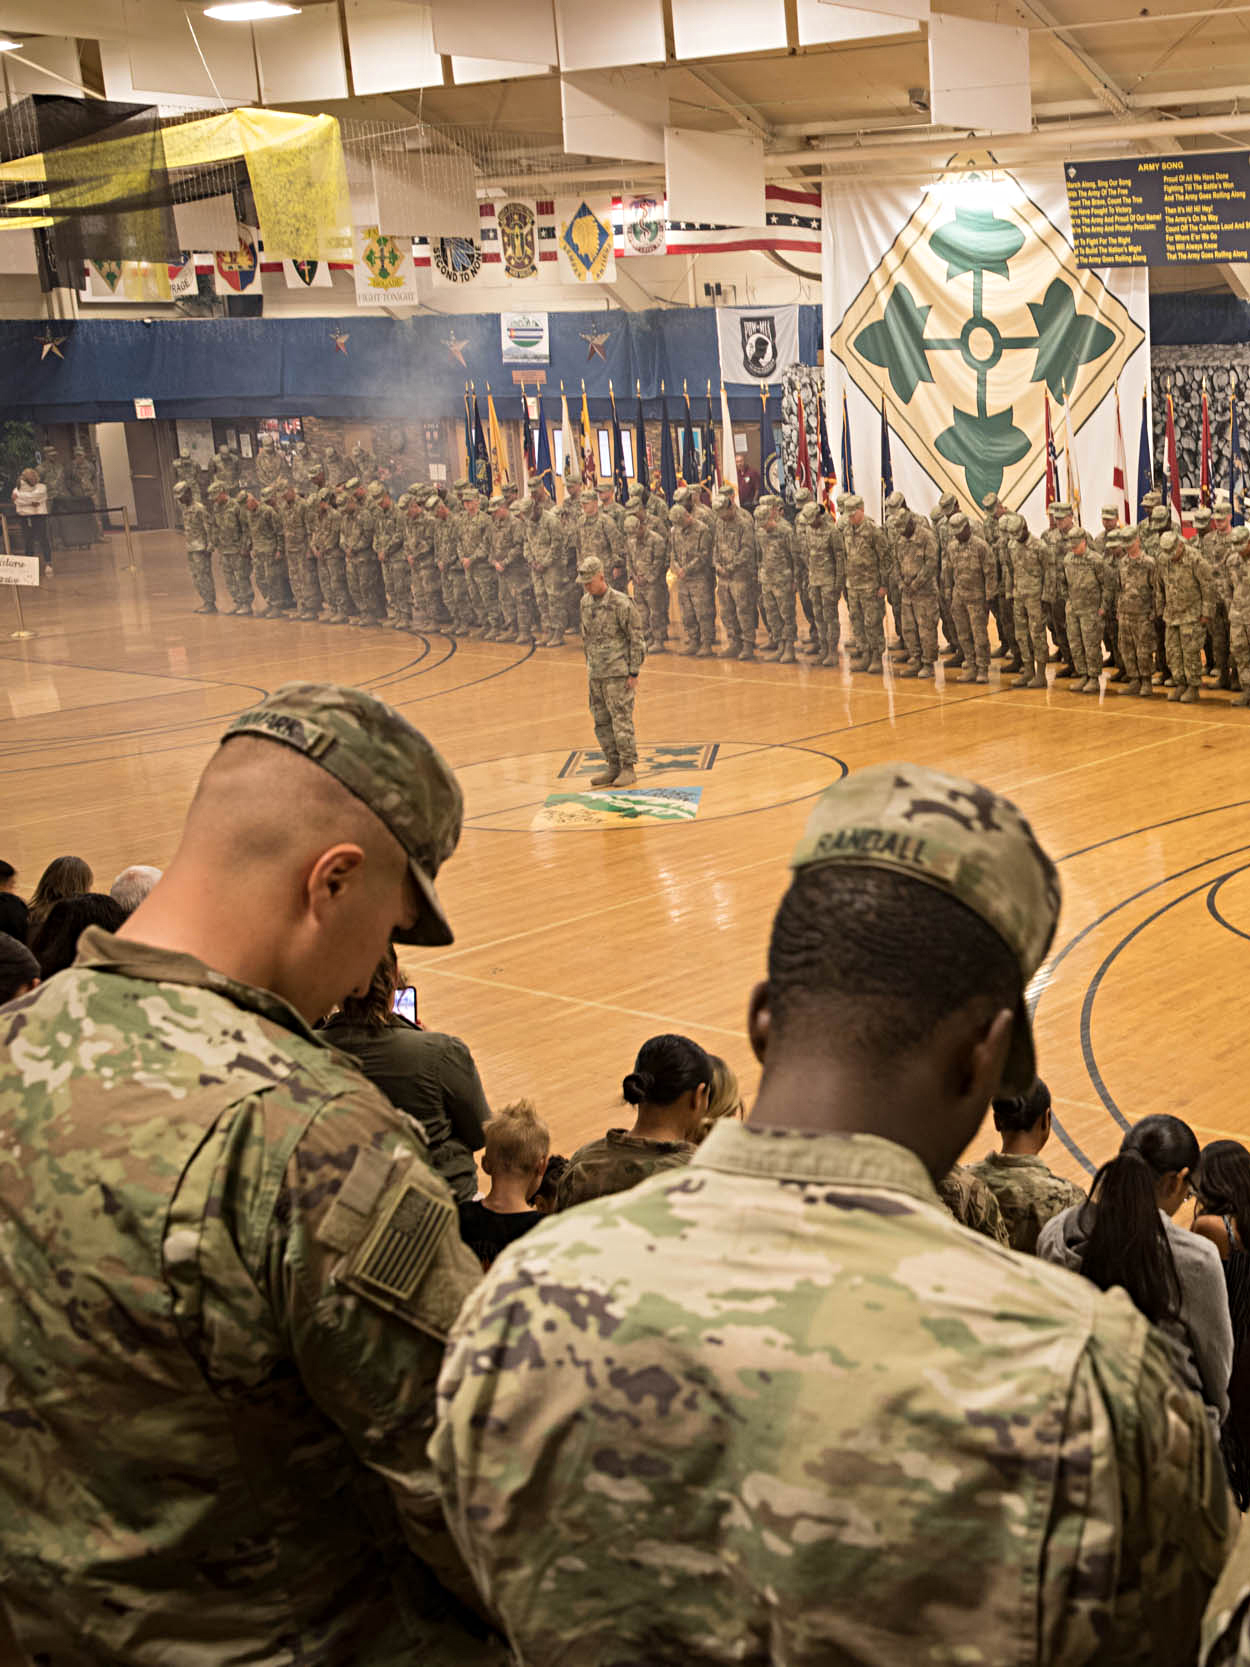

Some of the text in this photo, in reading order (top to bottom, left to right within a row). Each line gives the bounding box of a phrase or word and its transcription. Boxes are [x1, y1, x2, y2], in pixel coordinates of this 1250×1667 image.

[1138, 162, 1184, 172] ARMY SONG
[432, 245, 482, 284] SECOND TO NONE
